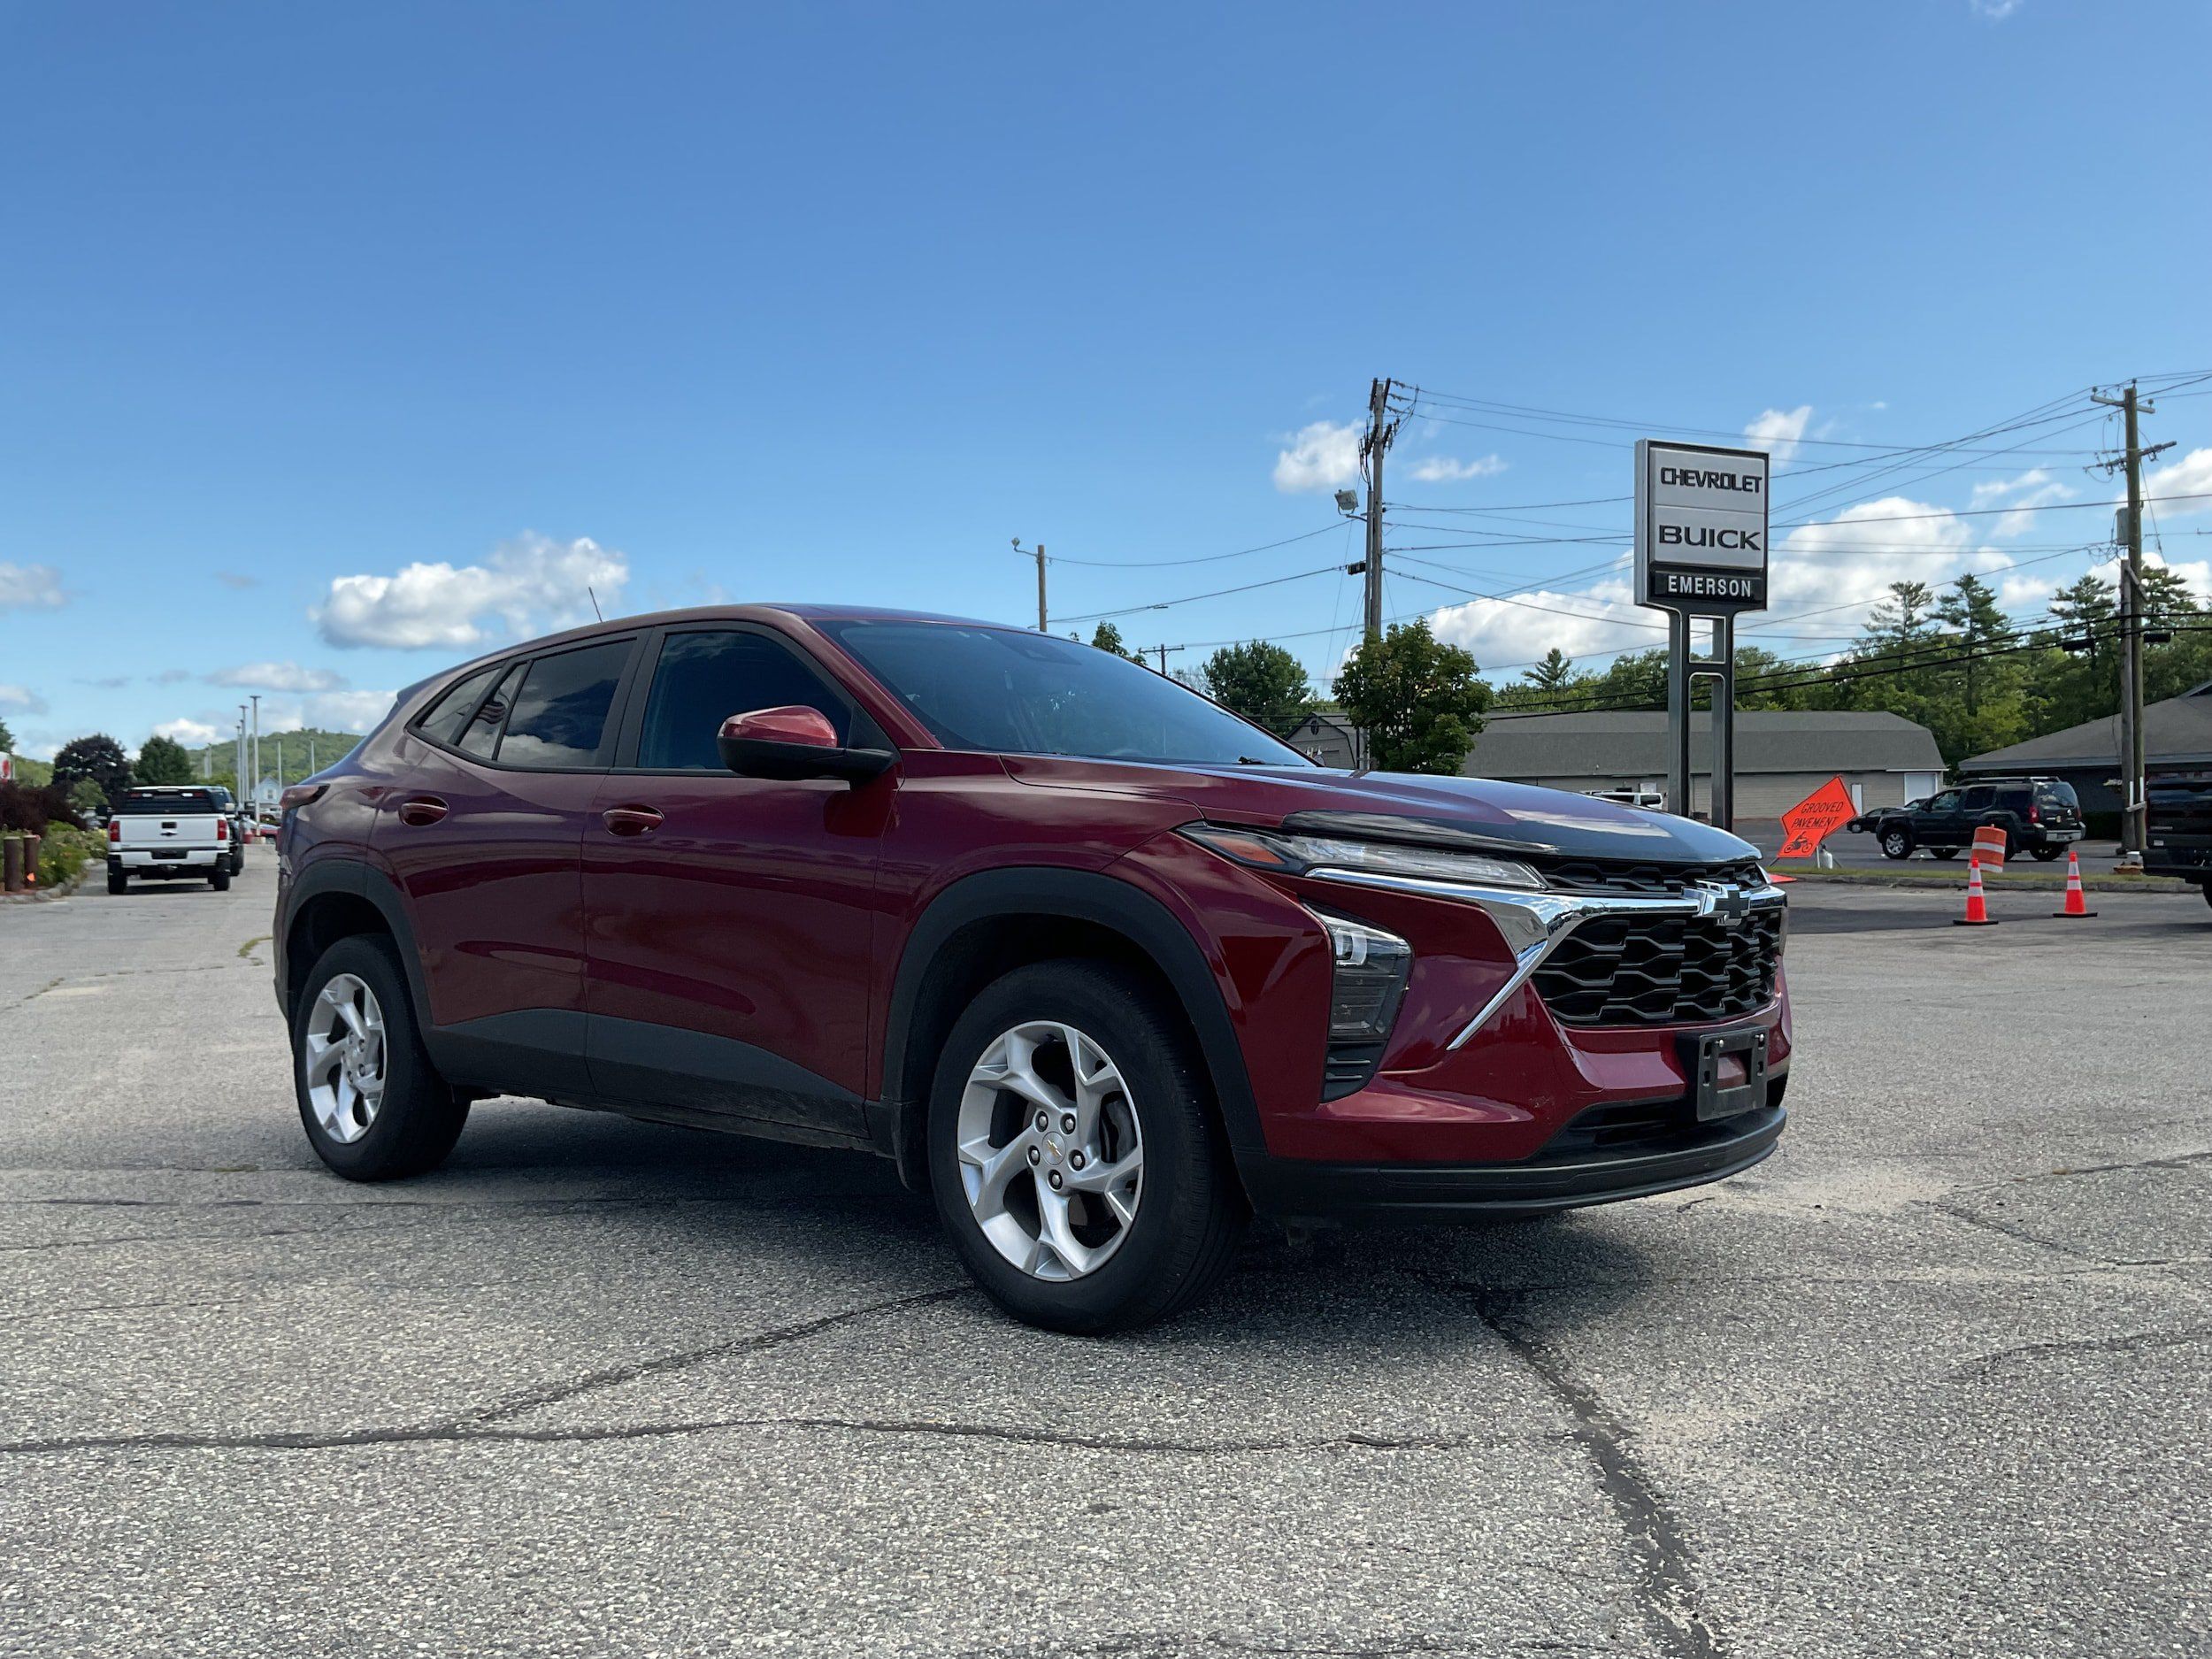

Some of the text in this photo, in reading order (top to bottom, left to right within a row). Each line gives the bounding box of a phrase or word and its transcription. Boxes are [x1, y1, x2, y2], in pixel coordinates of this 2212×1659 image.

[1660, 467, 1763, 493] CHEVROLET
[1659, 525, 1761, 550] BUICK
[1668, 575, 1751, 597] EMERSON
[1801, 802, 1844, 813] GROOVED
[1792, 817, 1839, 828] PAVEMENT
